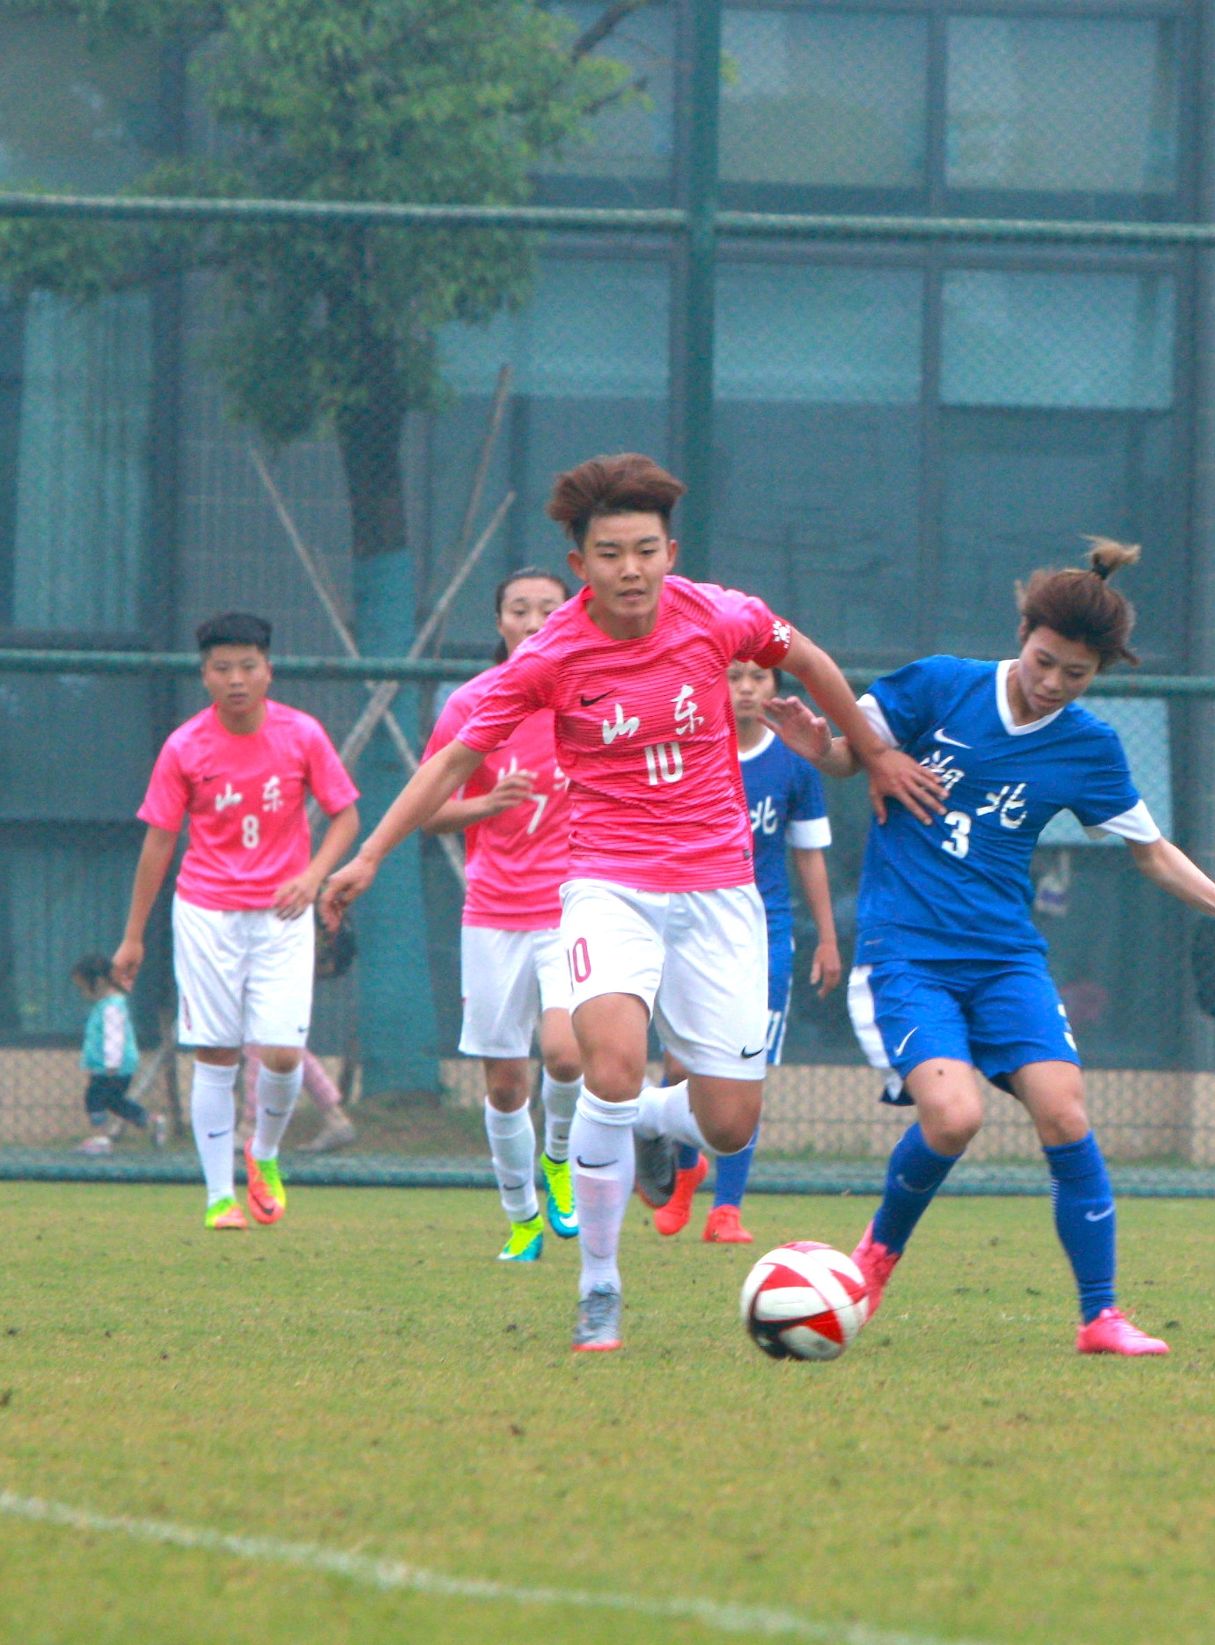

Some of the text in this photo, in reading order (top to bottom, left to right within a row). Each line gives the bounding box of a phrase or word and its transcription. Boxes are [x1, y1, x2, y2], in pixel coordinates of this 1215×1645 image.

[644, 741, 684, 785] 10
[241, 814, 259, 849] 8
[941, 810, 972, 859] 3
